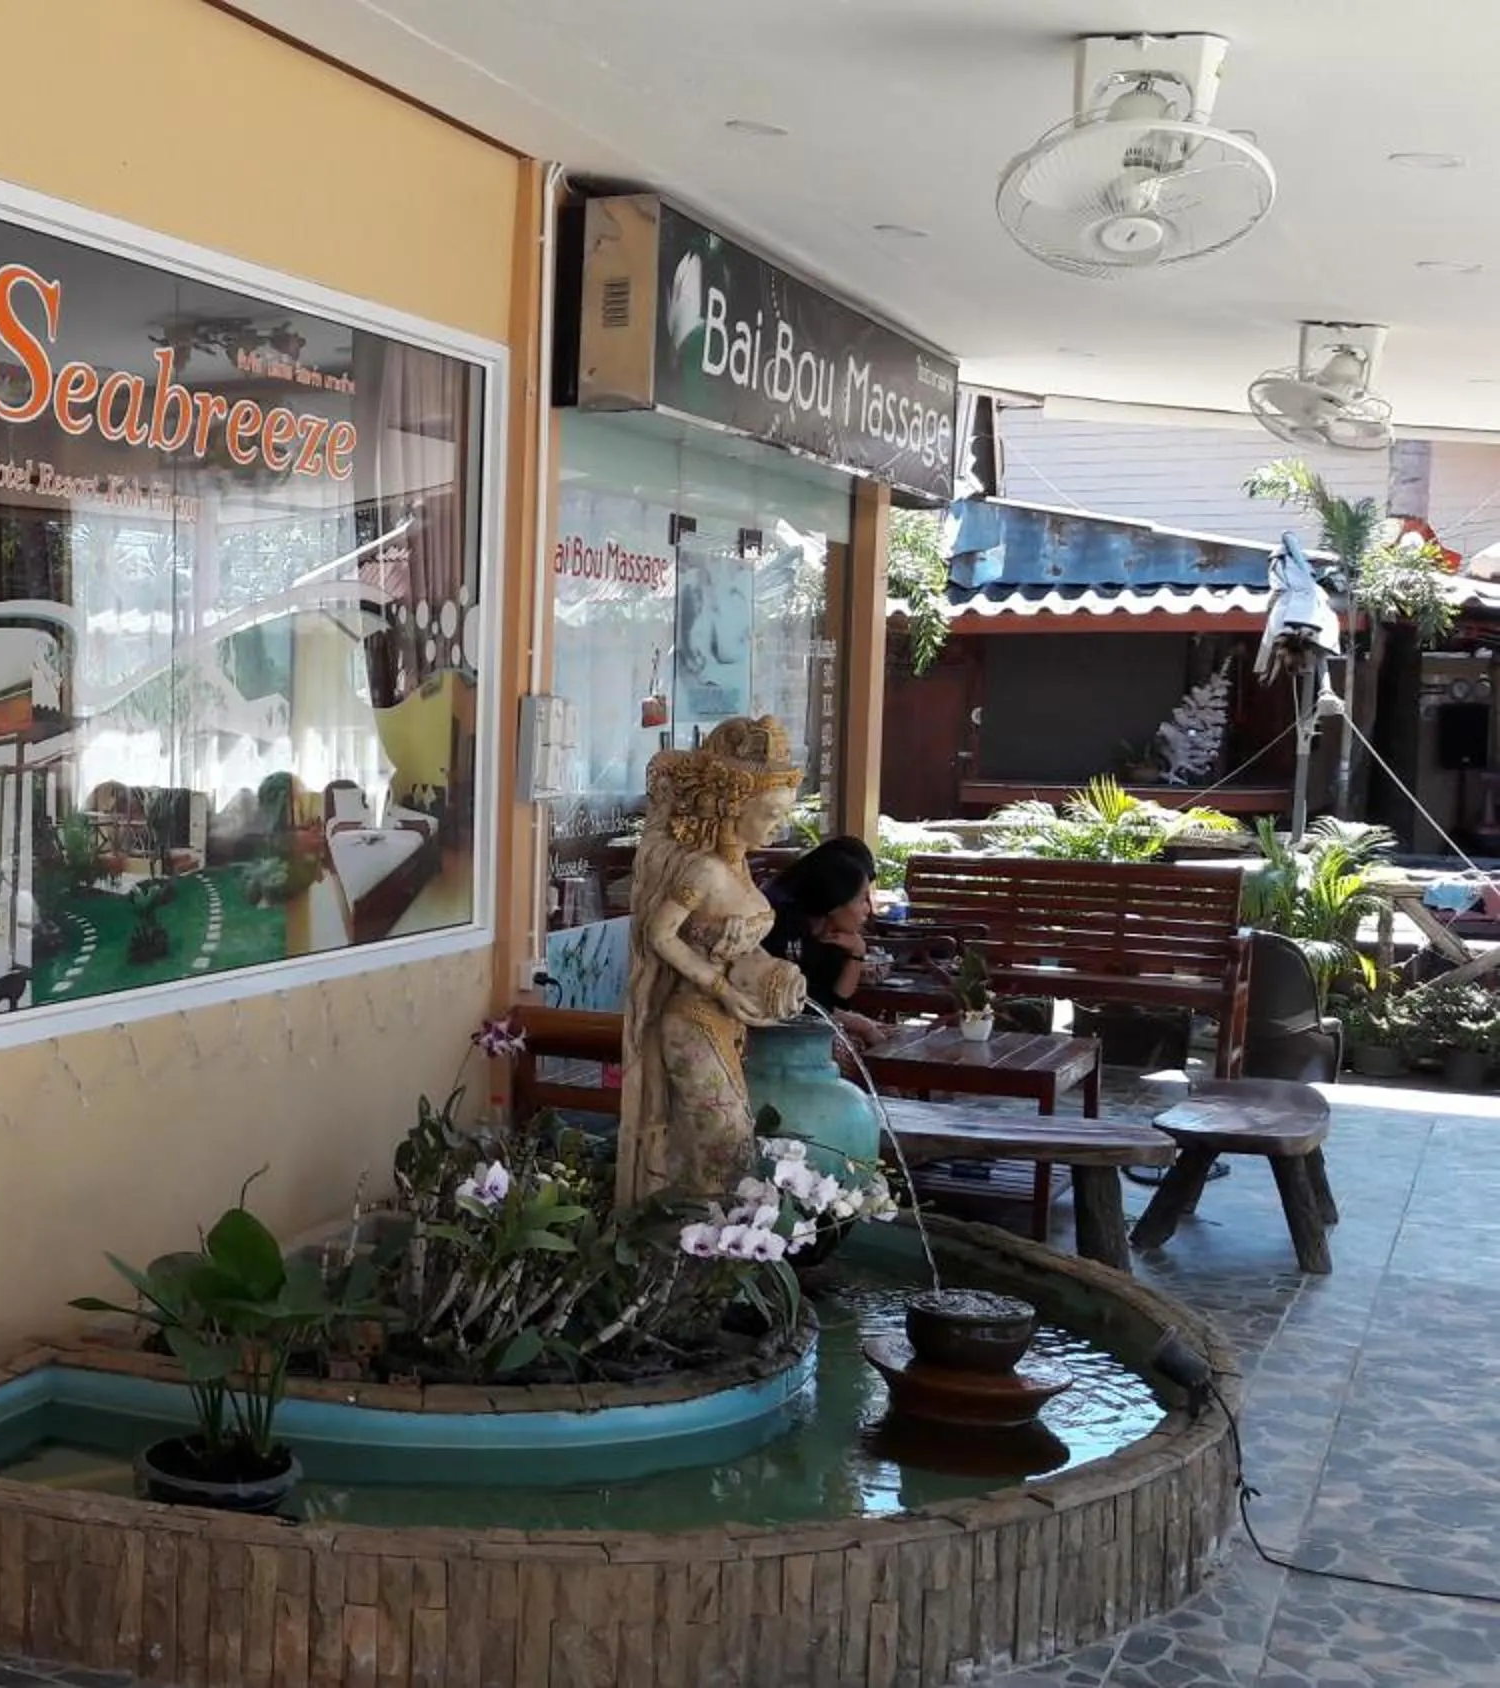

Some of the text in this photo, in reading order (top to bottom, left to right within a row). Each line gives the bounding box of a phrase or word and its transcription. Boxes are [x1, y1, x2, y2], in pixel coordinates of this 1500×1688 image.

[702, 286, 763, 391] Bai
[771, 319, 835, 420] Bou
[844, 355, 952, 468] Massage
[572, 536, 603, 580] Bou
[605, 541, 669, 591] Massage
